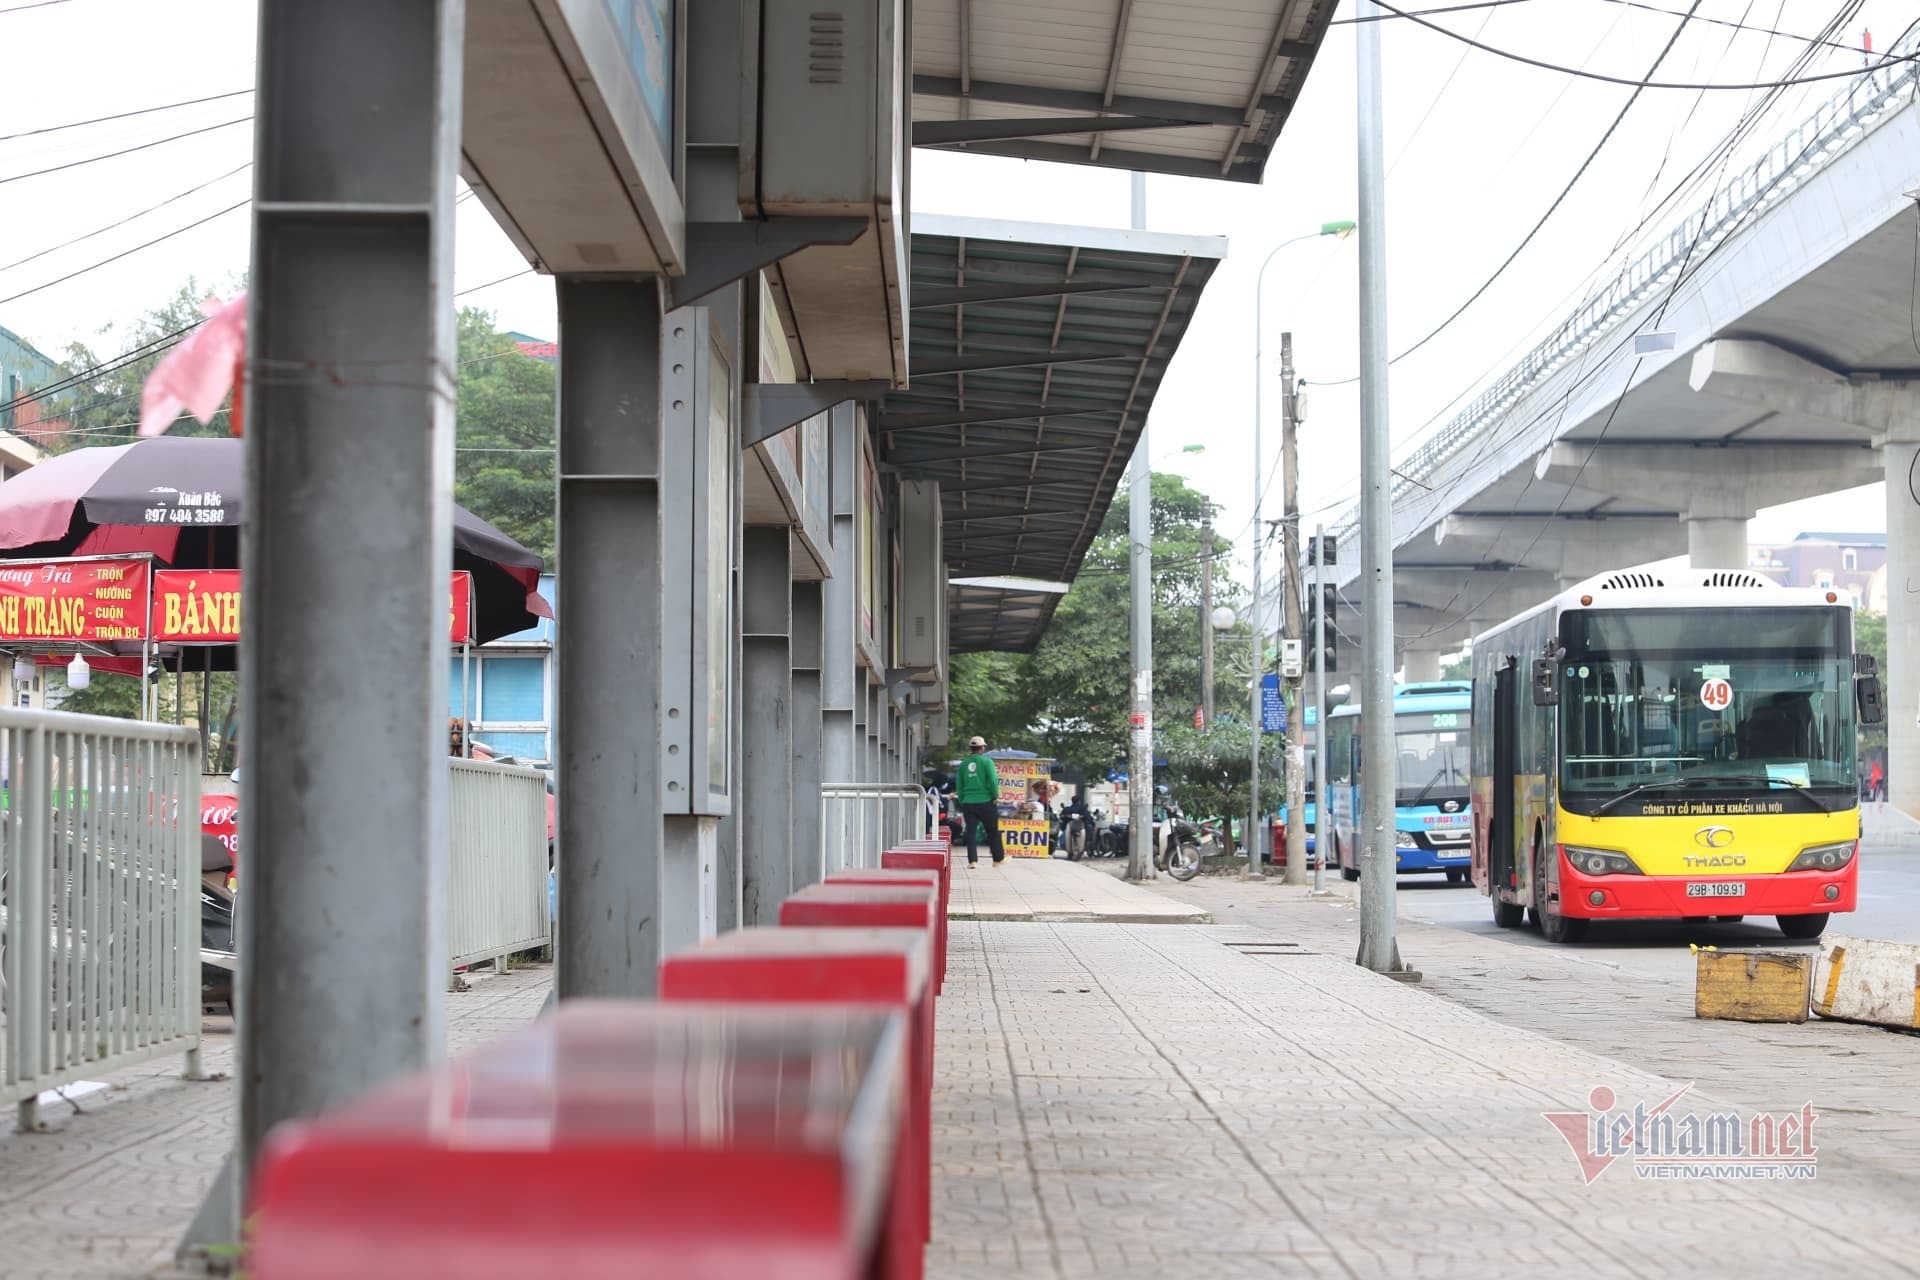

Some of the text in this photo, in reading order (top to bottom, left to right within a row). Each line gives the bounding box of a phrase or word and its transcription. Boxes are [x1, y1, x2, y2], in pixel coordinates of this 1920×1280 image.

[24, 587, 85, 636] TRÁNG
[164, 579, 242, 635] BÁNH
[1703, 683, 1729, 705] 49
[1666, 805, 1676, 814] TY
[1715, 804, 1725, 812] XE
[1683, 856, 1746, 868] THACO
[1688, 884, 1745, 896] 29B-109.91
